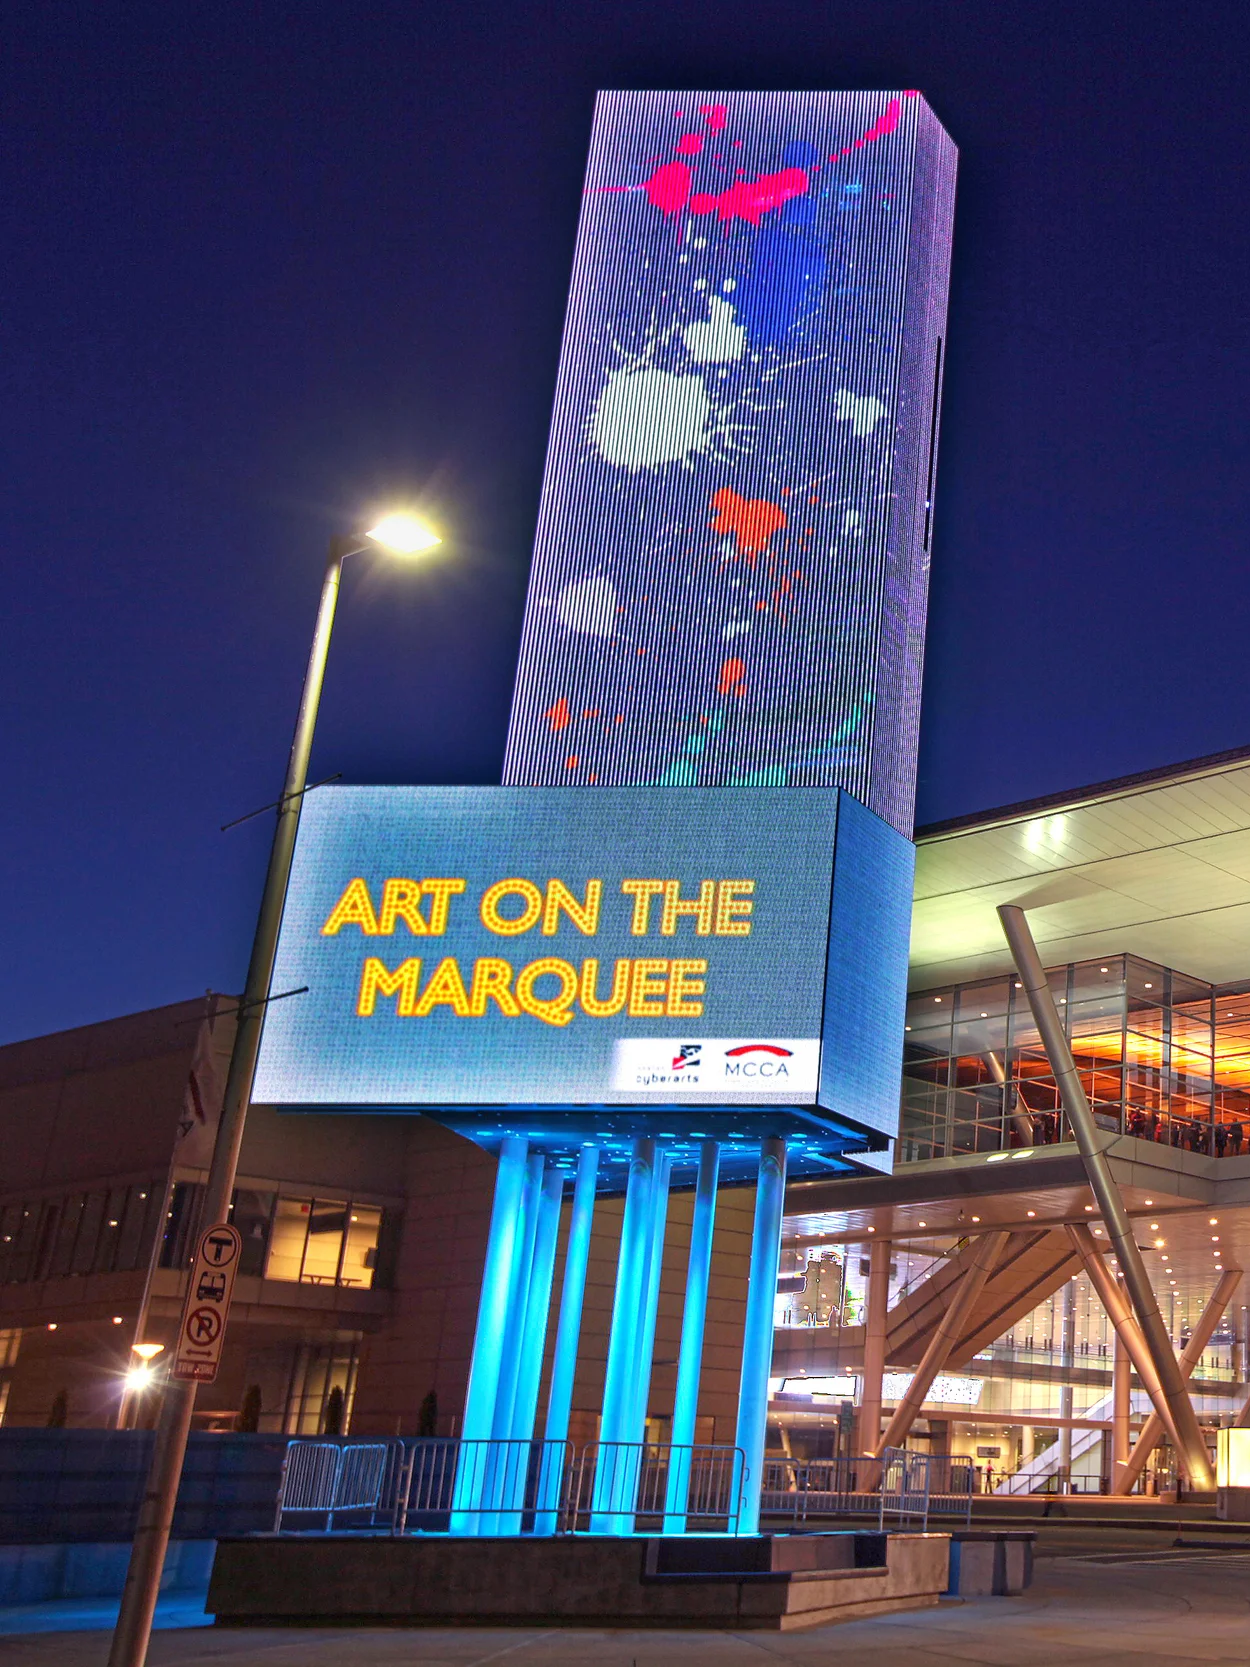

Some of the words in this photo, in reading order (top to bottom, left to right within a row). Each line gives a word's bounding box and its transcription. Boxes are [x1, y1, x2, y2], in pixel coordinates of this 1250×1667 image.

[320, 877, 466, 936] ART
[479, 877, 602, 936] ON
[621, 879, 755, 936] THE
[356, 956, 708, 1027] MARQUEE
[636, 1073, 699, 1085] cyberarts
[725, 1062, 789, 1077] MCCA
[209, 1236, 232, 1261] T
